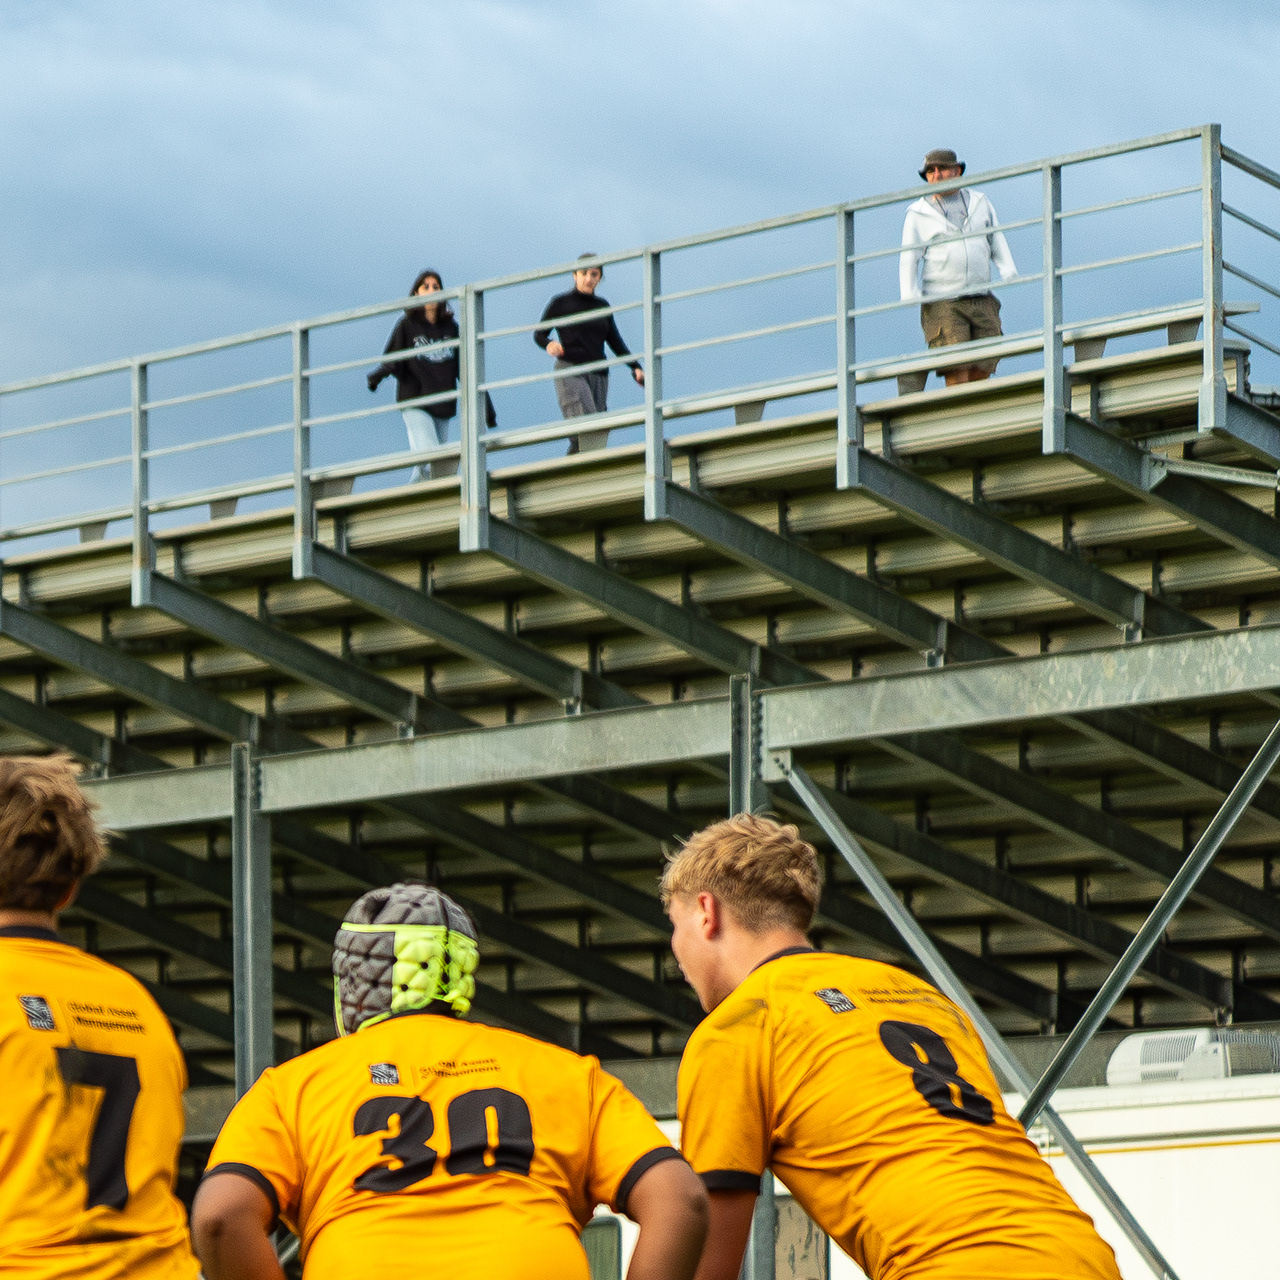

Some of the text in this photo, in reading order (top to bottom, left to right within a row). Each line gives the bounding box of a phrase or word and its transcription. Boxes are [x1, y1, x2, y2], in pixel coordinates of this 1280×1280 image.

[878, 1020, 994, 1125] 8
[53, 1046, 141, 1212] 7
[353, 1088, 535, 1192] 30
